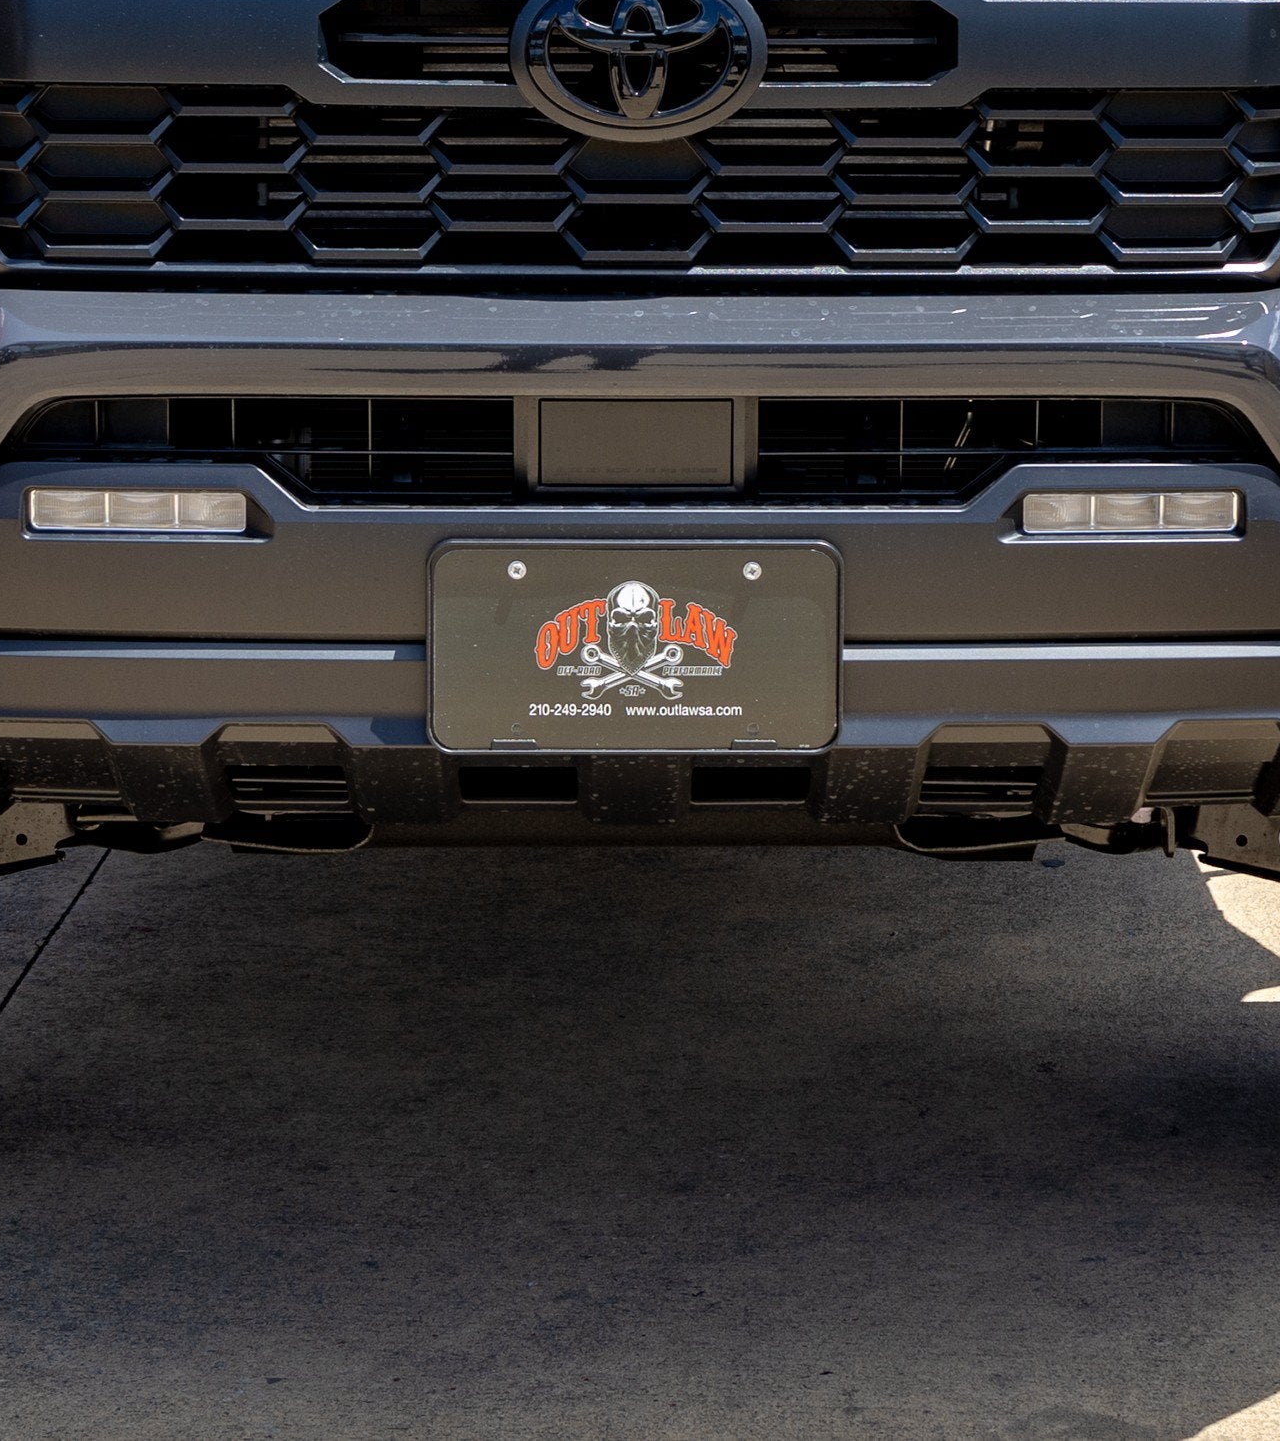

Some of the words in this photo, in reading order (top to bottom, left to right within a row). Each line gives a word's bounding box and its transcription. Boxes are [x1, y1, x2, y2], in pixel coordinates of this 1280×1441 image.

[534, 598, 608, 670] OUT
[658, 598, 738, 668] LAW
[556, 665, 603, 676] OFF-ROAD
[661, 665, 723, 676] PERFORMANCE
[528, 703, 612, 716] 210-249-2940
[625, 703, 743, 717] www.outlawsa.com
